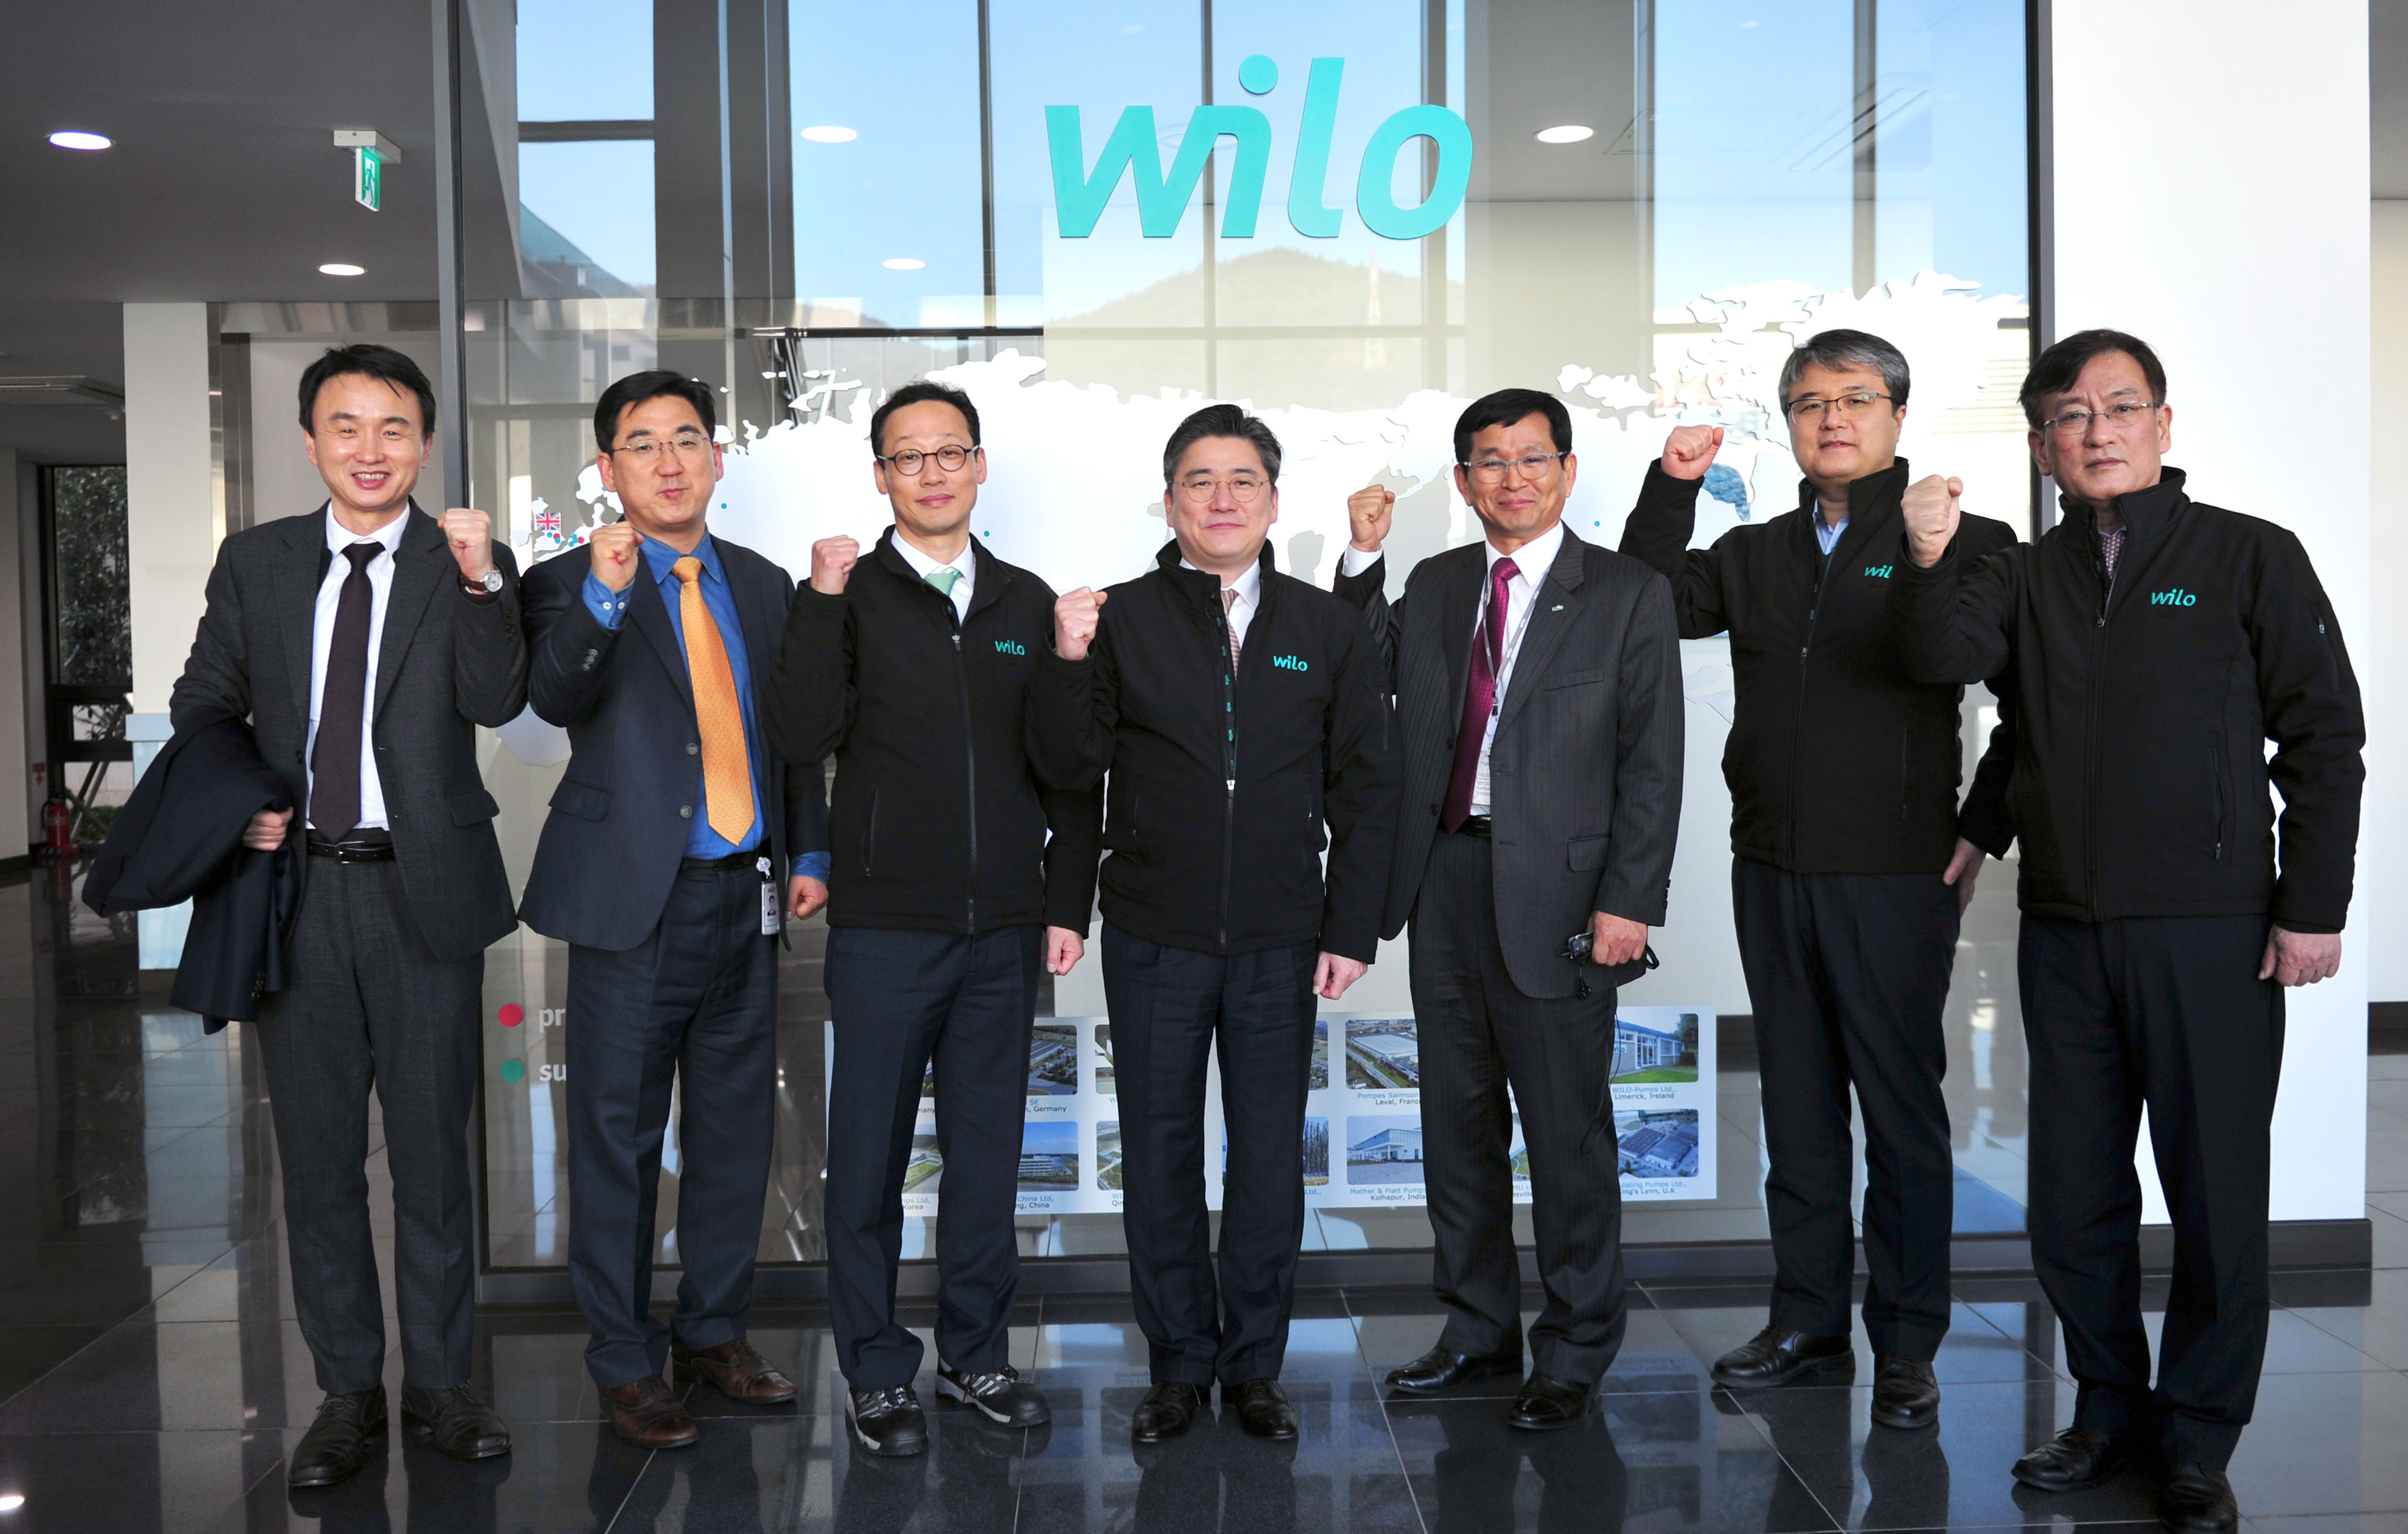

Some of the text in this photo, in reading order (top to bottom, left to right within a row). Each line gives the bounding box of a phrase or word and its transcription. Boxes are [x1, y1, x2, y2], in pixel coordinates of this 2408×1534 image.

[1045, 54, 1473, 240] wilo
[1864, 565, 1893, 578] wil
[2151, 588, 2196, 607] wilo
[994, 640, 1025, 655] wilo
[1273, 655, 1308, 671] wilo
